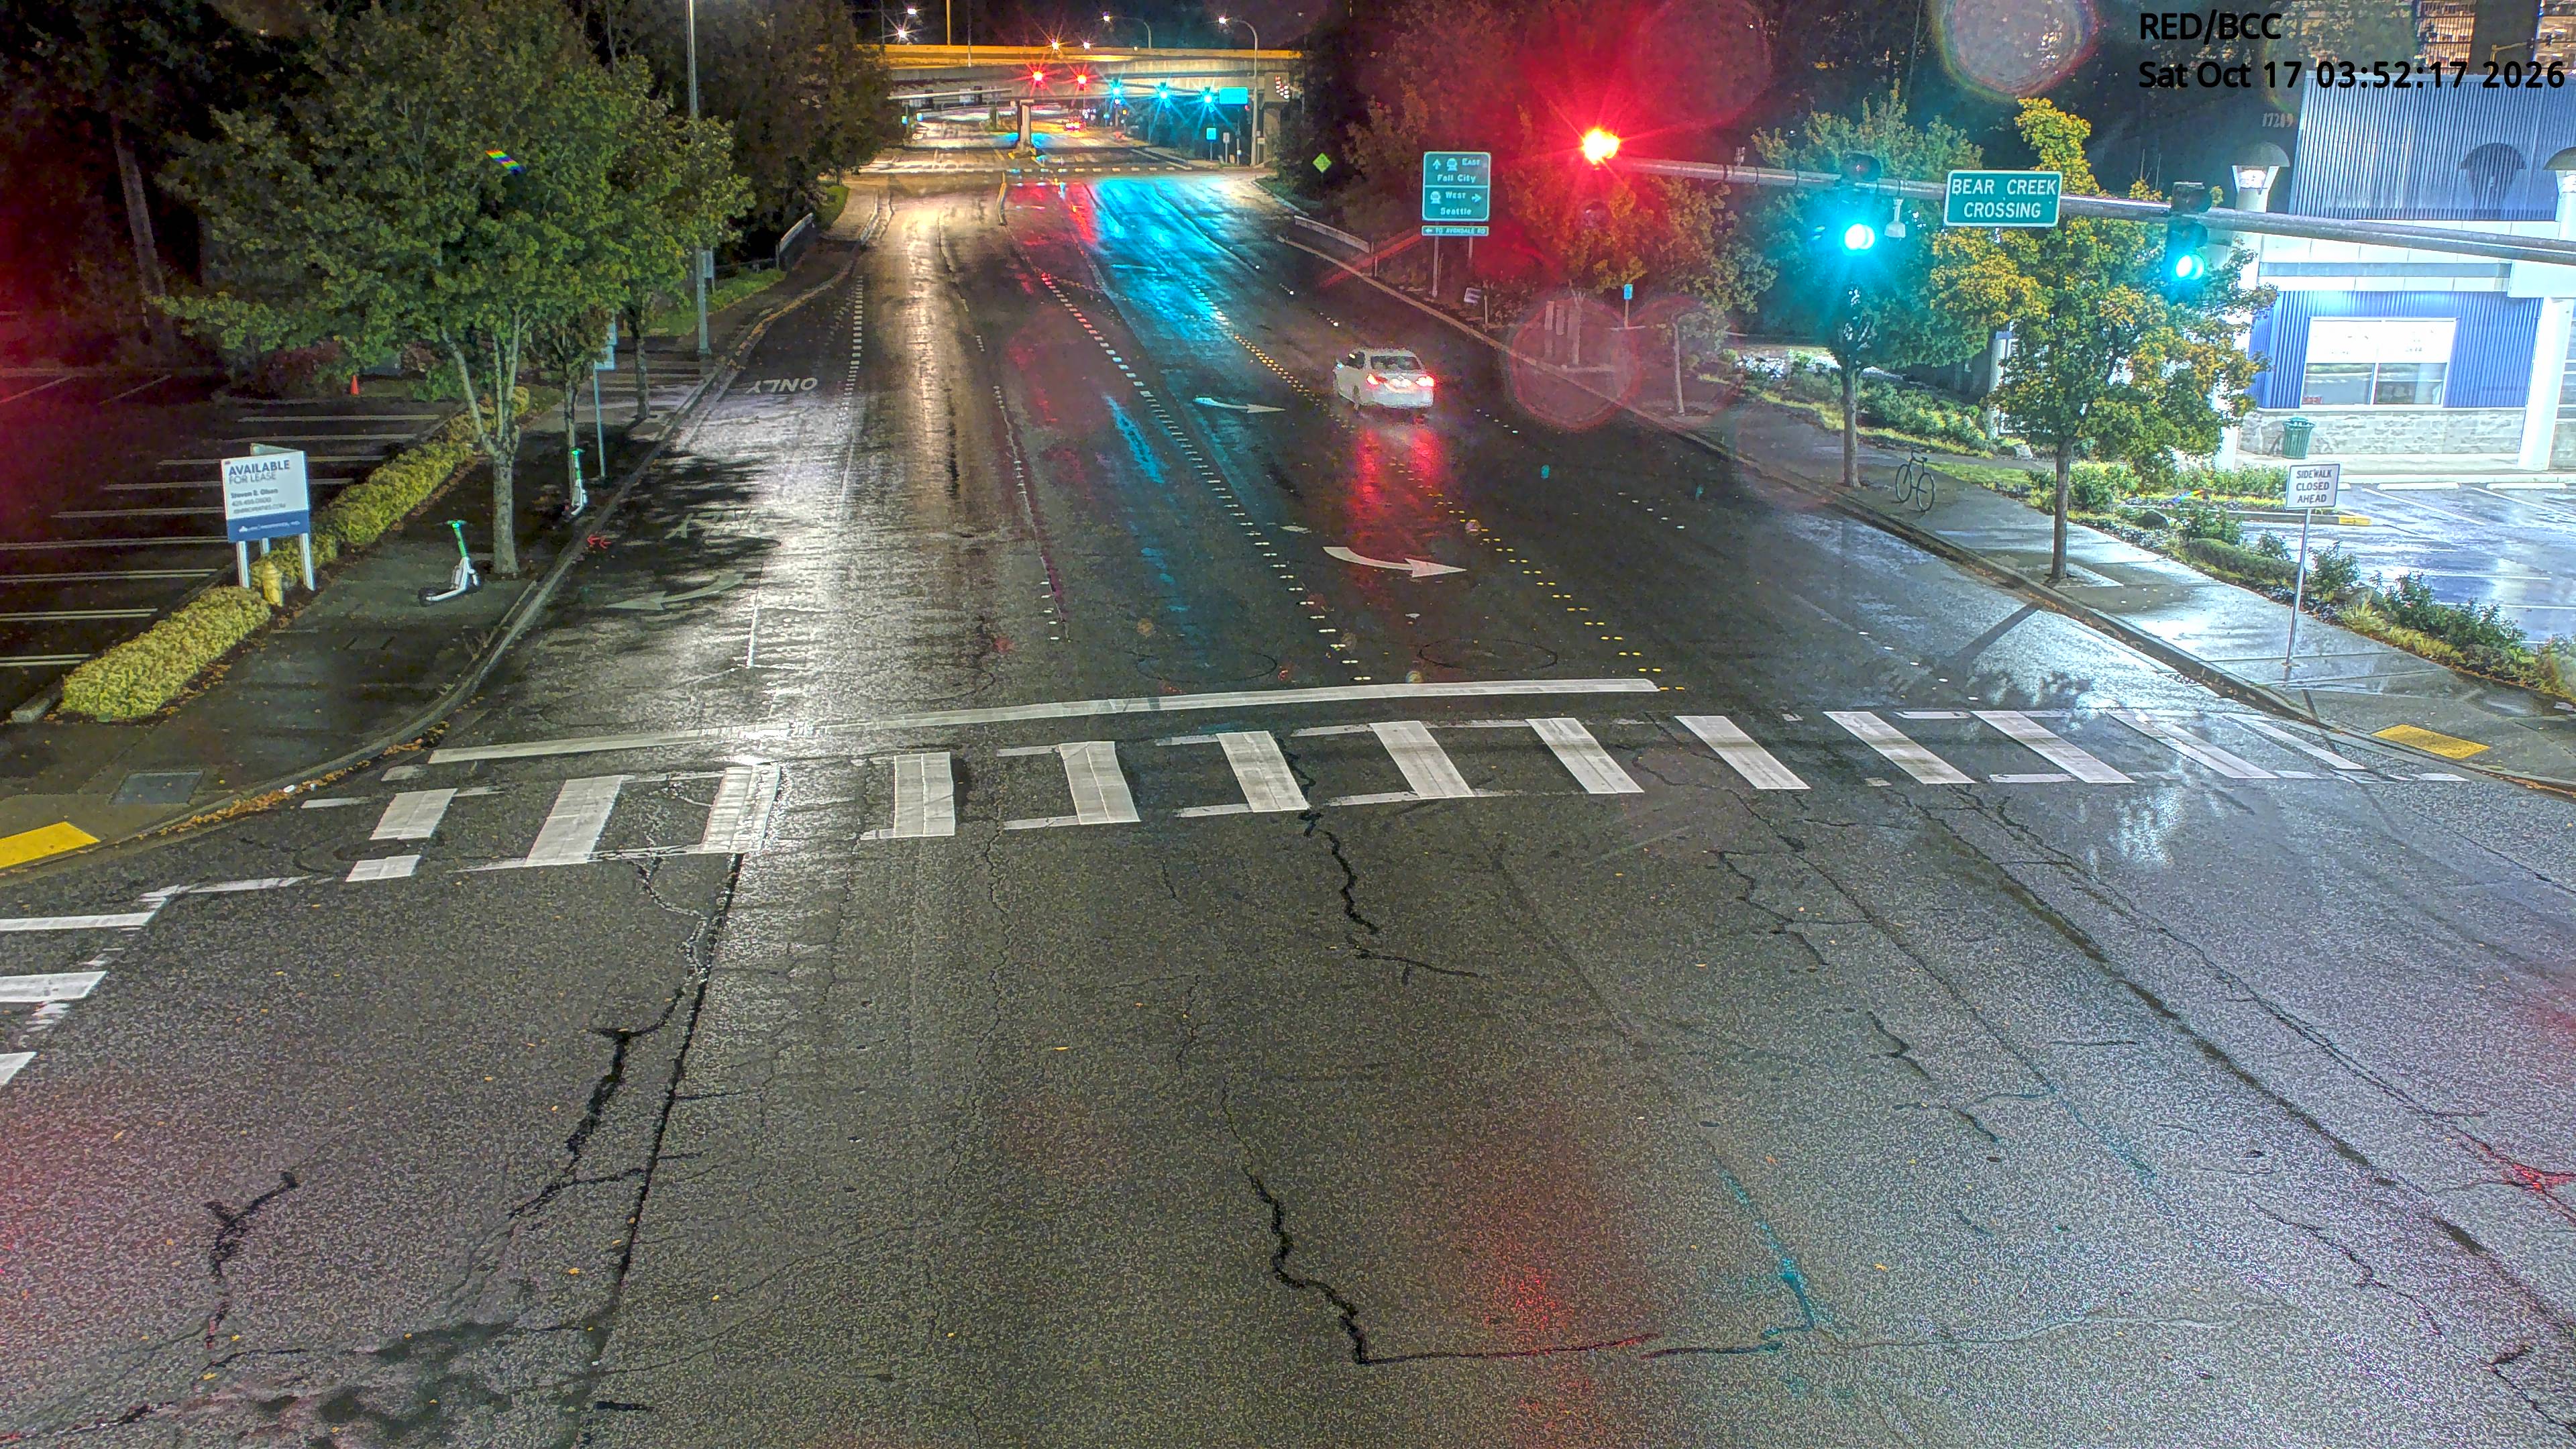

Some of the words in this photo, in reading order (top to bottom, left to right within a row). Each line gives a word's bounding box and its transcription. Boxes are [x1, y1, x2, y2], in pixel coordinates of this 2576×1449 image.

[1437, 174, 1454, 182] Fall
[1457, 174, 1477, 183] City
[1951, 178, 1995, 196] BEAR
[2006, 179, 2057, 195] CREEK
[1440, 207, 1472, 215] Seattle
[1964, 202, 2041, 218] CROSSING
[746, 377, 818, 394] ONLY
[229, 460, 290, 476] AVAILABLE
[2296, 468, 2332, 479] SIDEWALK
[229, 475, 248, 484] FOR
[250, 472, 276, 482] LEASE
[2296, 482, 2330, 491] CLOSED
[2297, 494, 2327, 504] AHEAD
